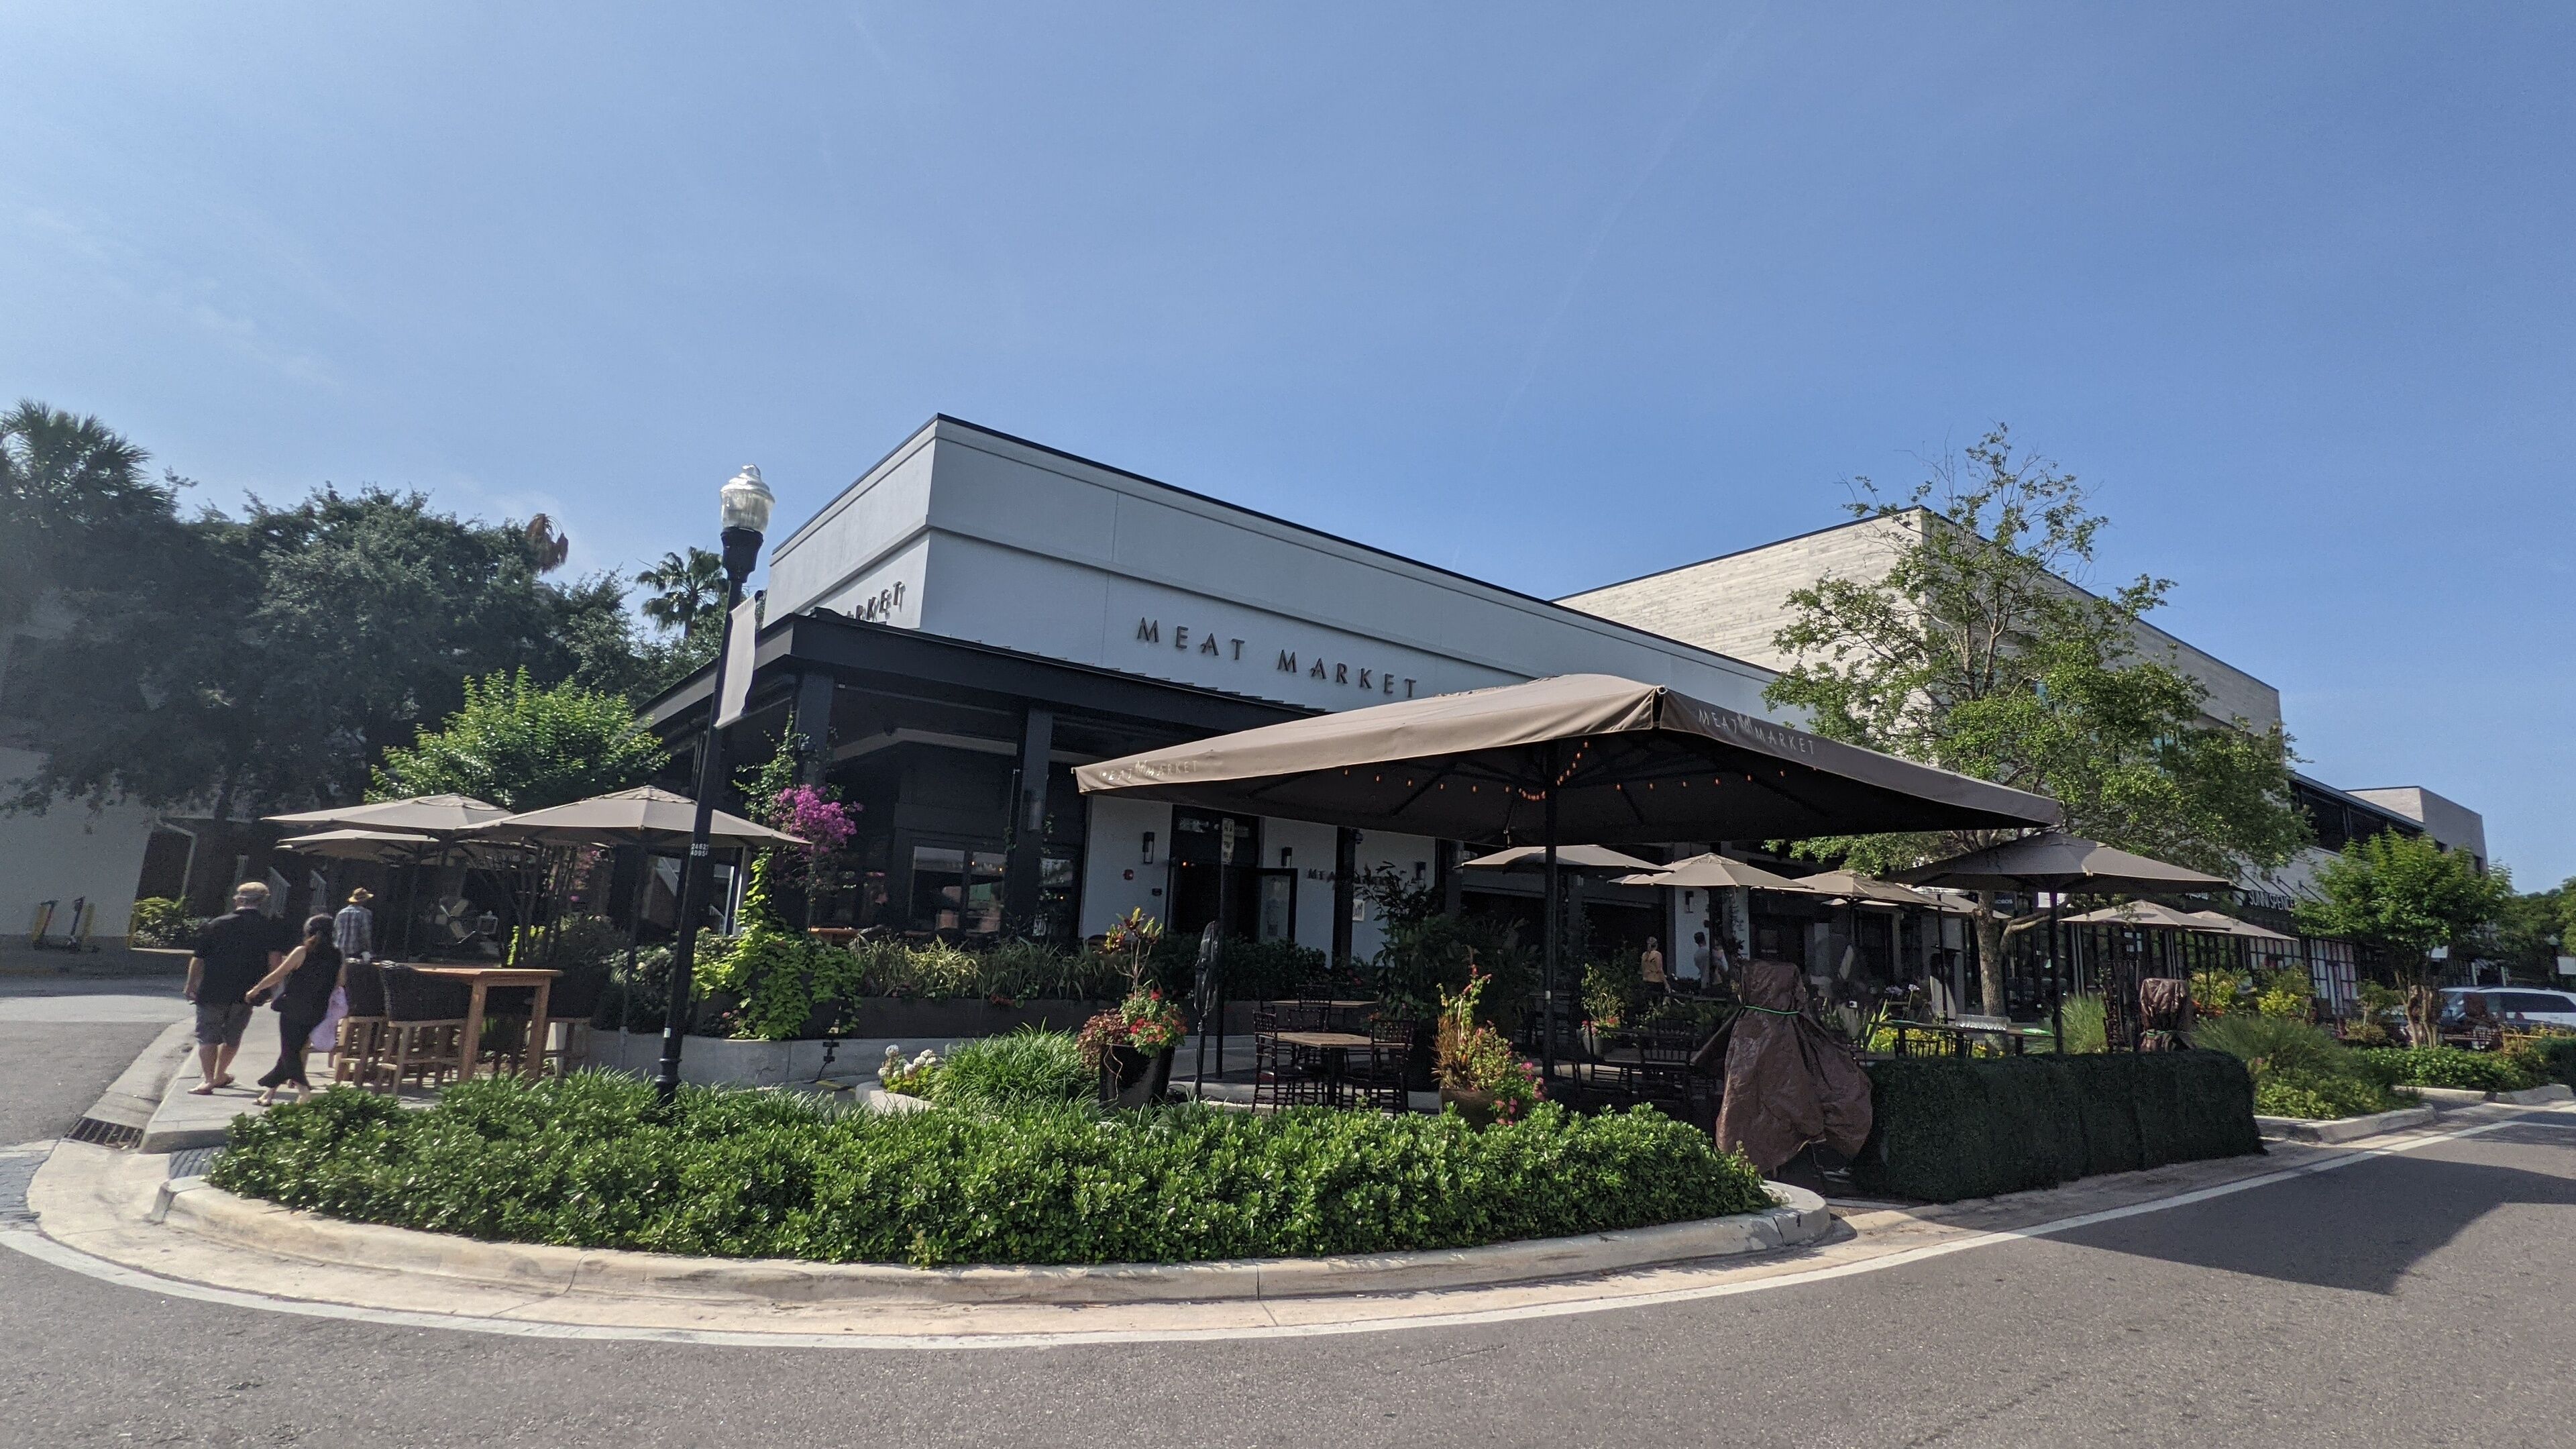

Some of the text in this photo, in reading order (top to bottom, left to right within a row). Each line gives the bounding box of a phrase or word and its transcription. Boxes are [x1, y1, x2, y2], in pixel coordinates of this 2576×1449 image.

[1137, 616, 1417, 698] MEAT MARKET
[1699, 708, 1737, 733] MEAT
[1754, 727, 1814, 755] MARKET
[1146, 760, 1197, 777] MARKET
